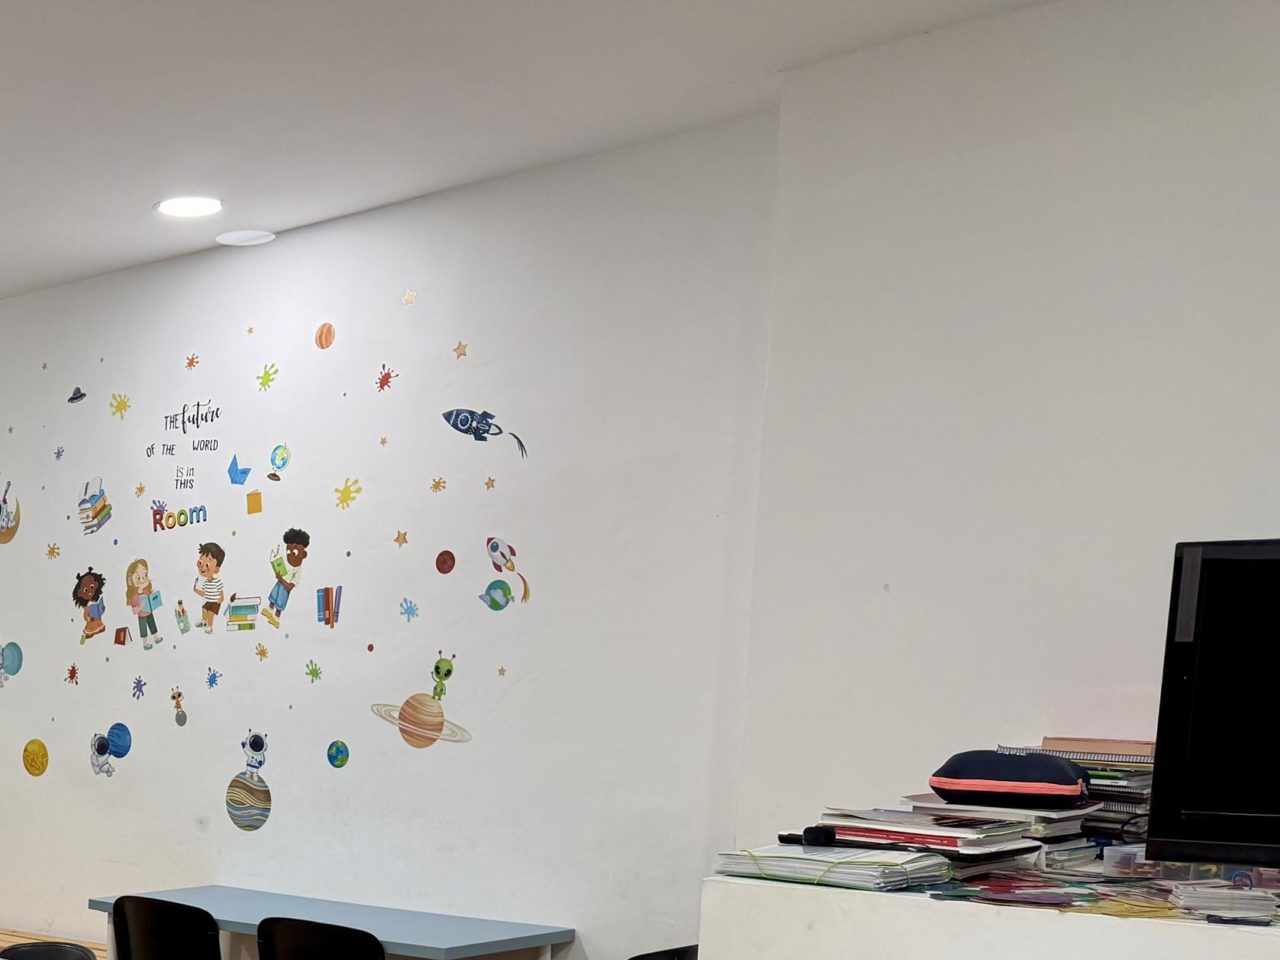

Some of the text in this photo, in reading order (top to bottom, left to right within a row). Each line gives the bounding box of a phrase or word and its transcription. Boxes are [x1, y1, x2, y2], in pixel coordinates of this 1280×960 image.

[164, 399, 222, 434] THE future
[146, 439, 219, 458] OF THE WORLD
[176, 465, 195, 477] is in
[174, 478, 195, 490] THIS
